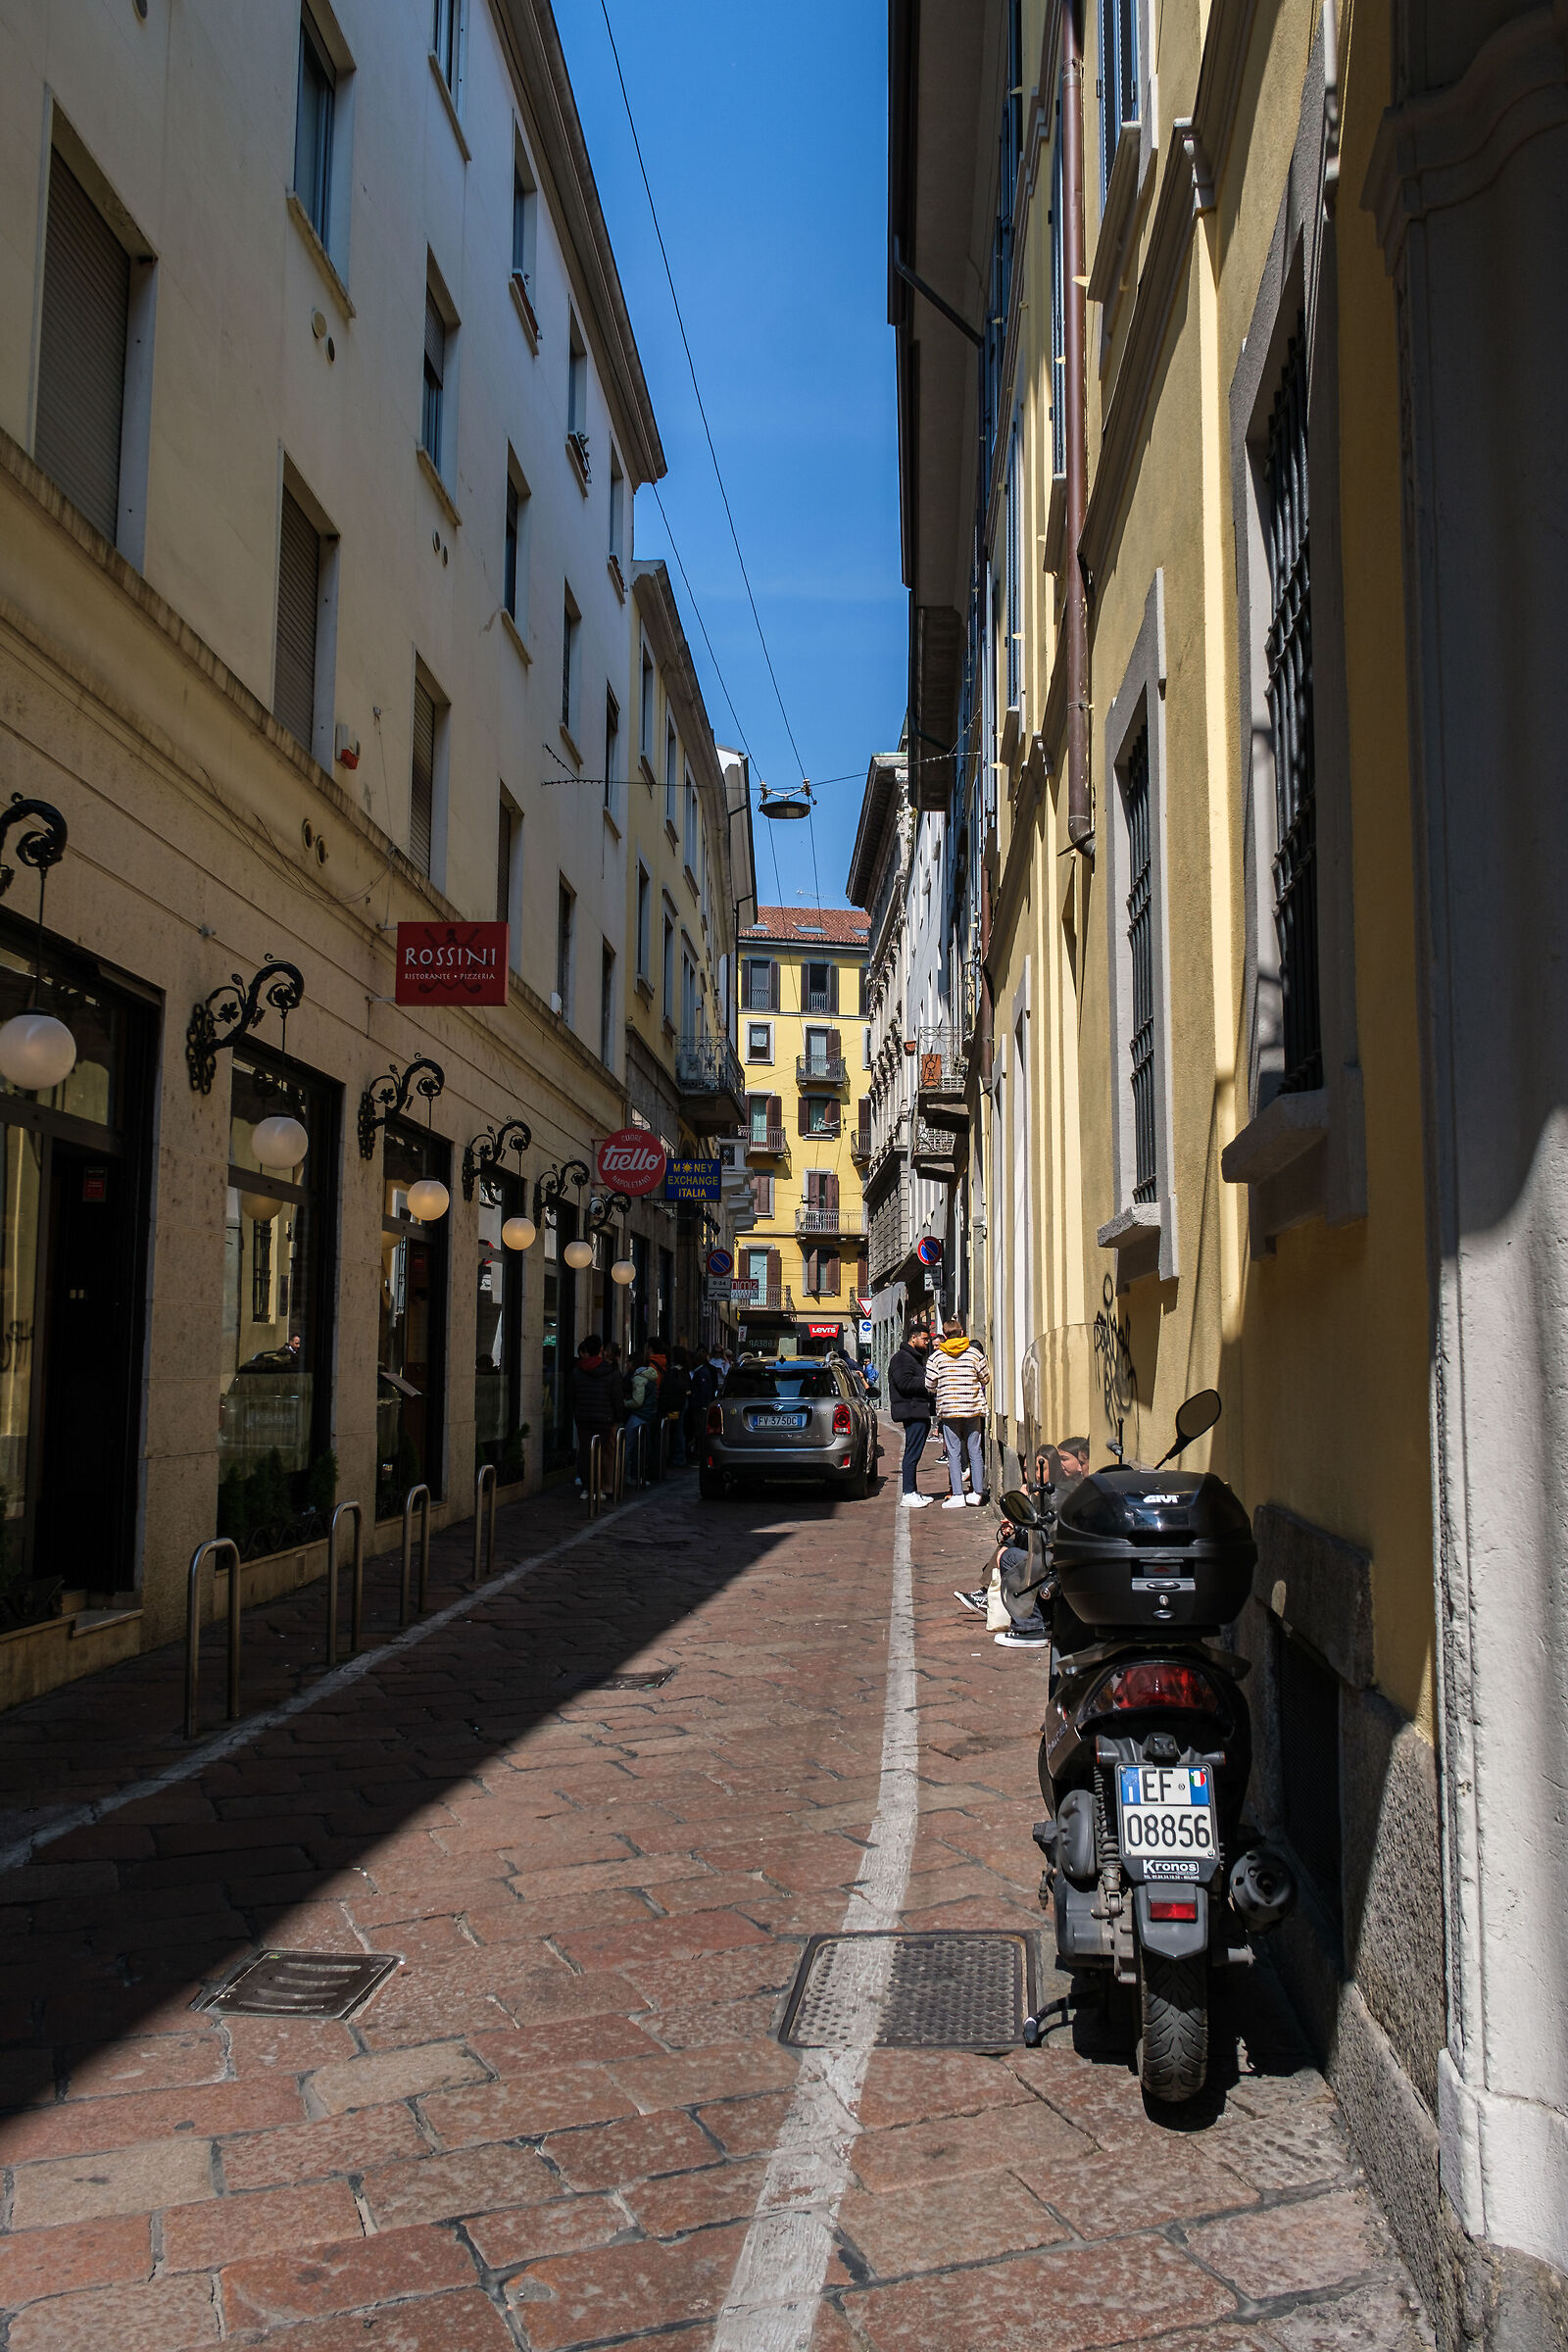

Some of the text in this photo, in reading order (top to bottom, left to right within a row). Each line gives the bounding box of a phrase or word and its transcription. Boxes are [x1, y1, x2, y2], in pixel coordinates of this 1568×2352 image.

[405, 947, 496, 966] ROSSINI
[620, 1134, 643, 1143] CUORE
[611, 1175, 652, 1189] NAPOLETANO
[667, 1175, 718, 1186] EXCHANGE
[678, 1188, 707, 1198] ITALIA
[1143, 1494, 1179, 1503] GIVI
[1142, 1769, 1174, 1802] EF
[1127, 1814, 1210, 1848] 08856
[1143, 1860, 1197, 1874] Kronos
